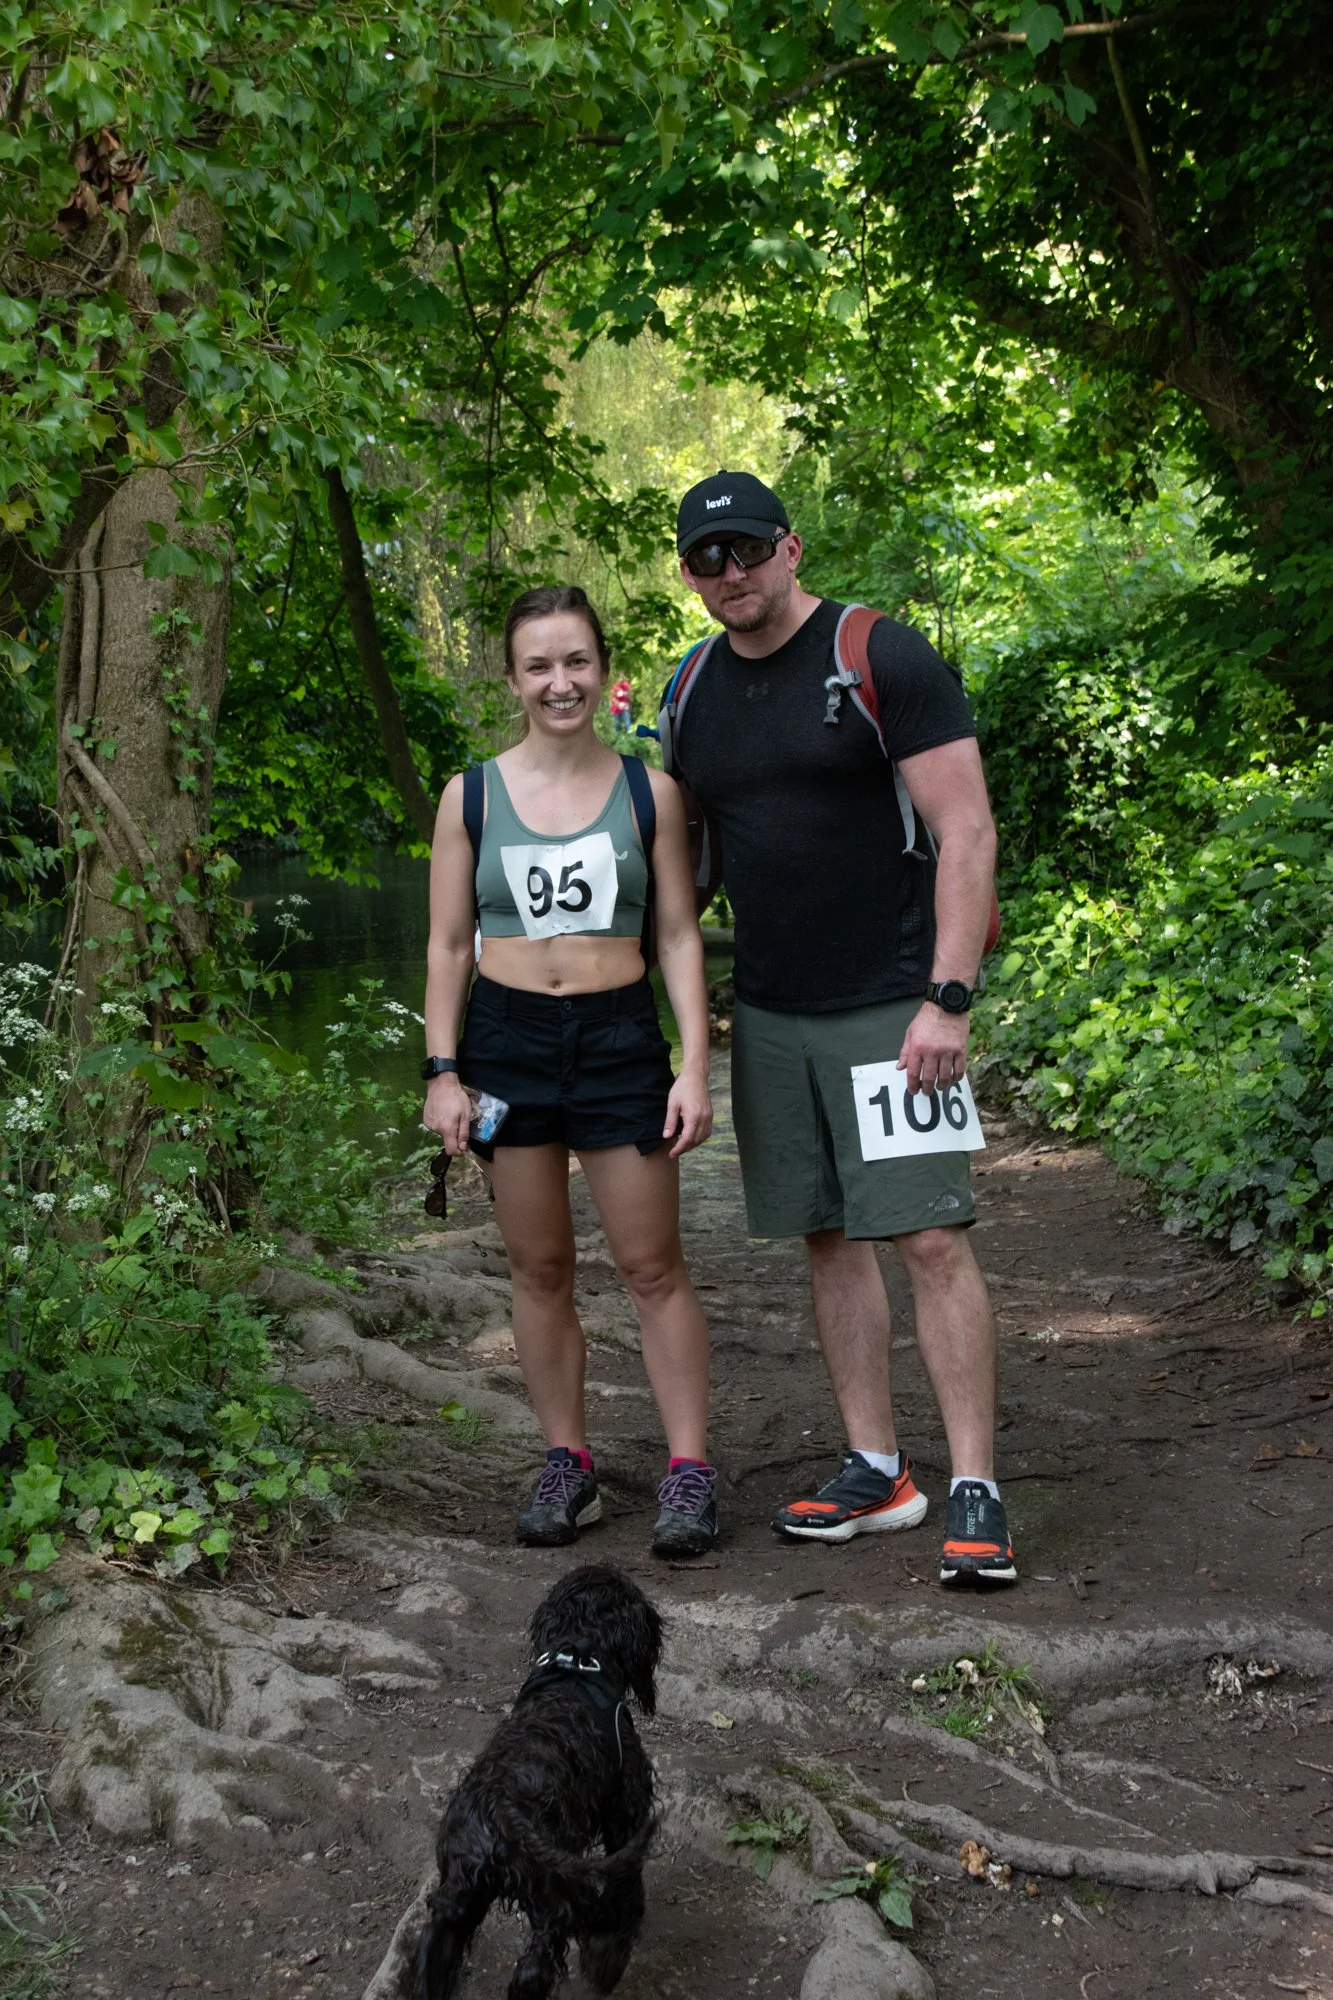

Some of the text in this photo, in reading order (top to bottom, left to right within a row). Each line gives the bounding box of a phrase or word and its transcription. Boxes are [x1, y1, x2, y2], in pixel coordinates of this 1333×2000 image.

[706, 496, 731, 509] levi's
[527, 860, 592, 918] 95
[869, 1082, 968, 1137] 106
